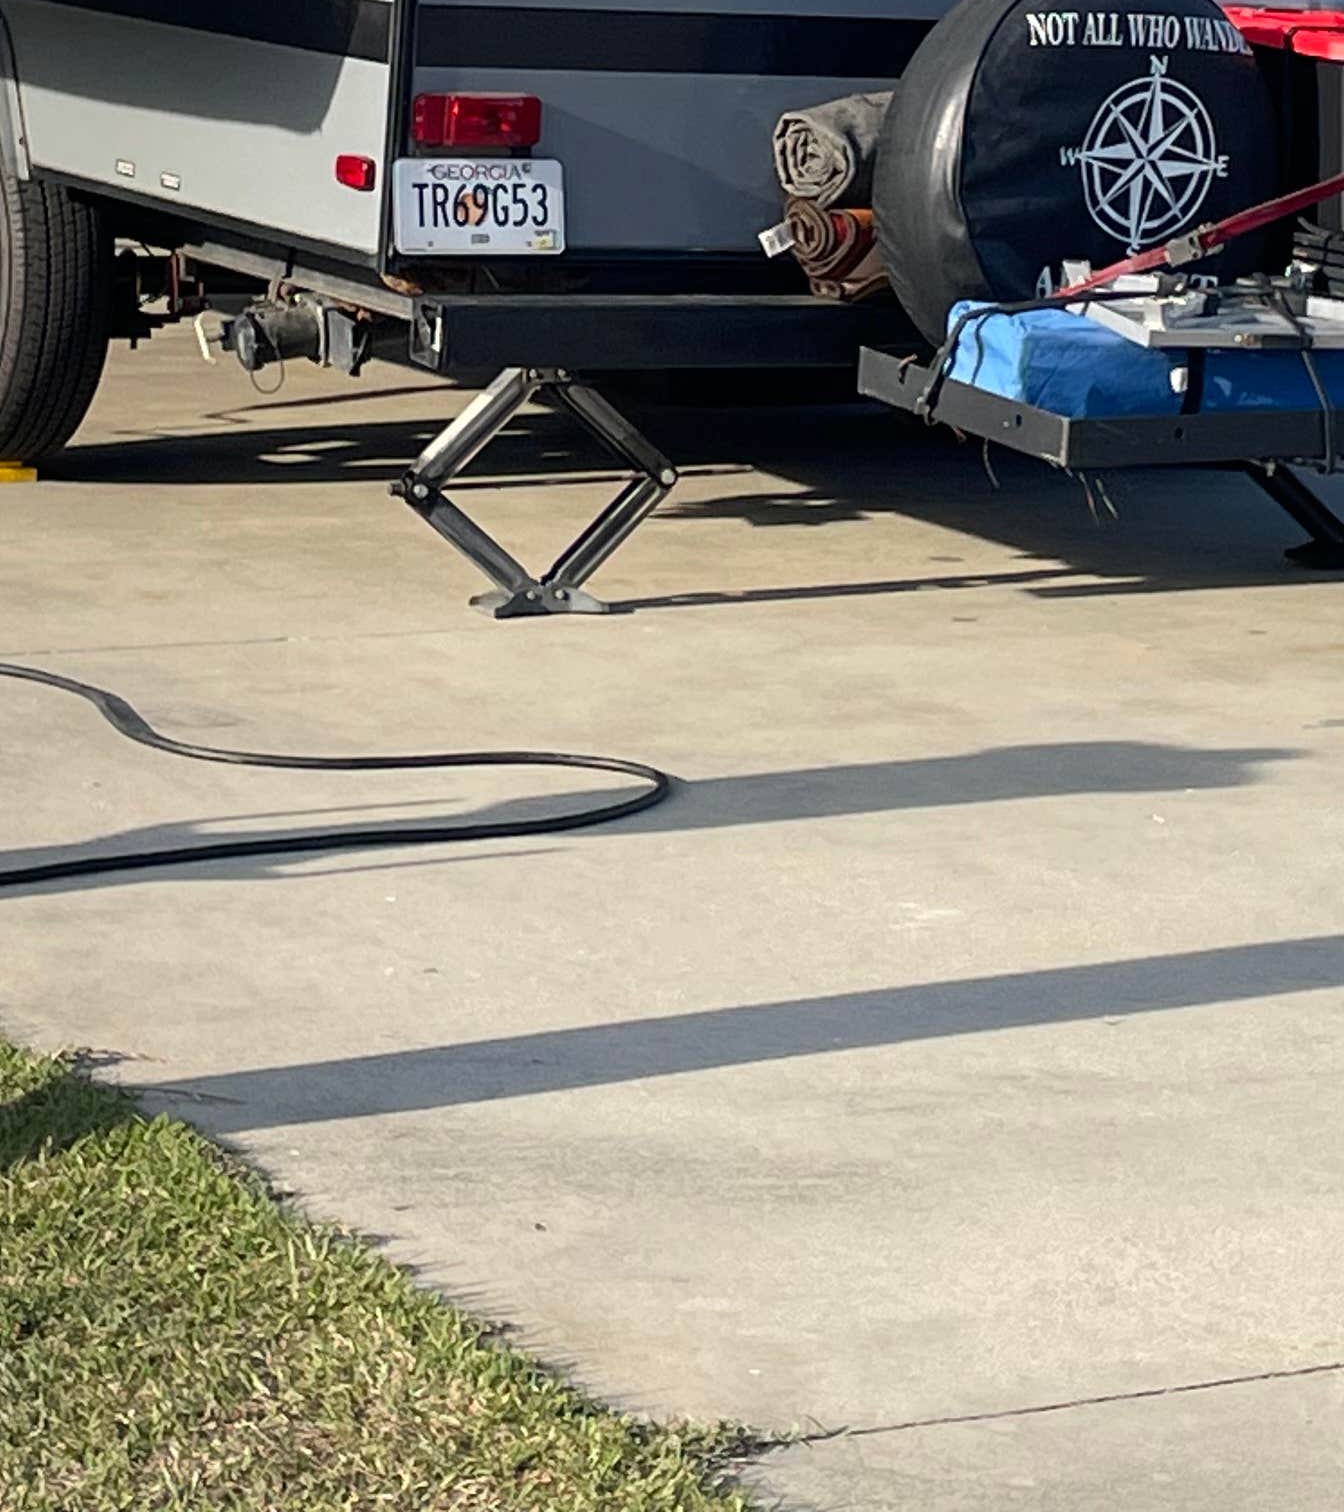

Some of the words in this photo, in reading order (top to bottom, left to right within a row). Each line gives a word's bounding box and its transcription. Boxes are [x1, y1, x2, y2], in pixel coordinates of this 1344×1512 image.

[1026, 12, 1079, 46] NOT
[1083, 13, 1123, 46] ALL
[1127, 14, 1180, 49] WHO
[1150, 55, 1168, 75] N
[1060, 146, 1081, 166] W
[431, 164, 522, 180] GEORGIA
[1216, 156, 1230, 177] E
[412, 184, 548, 227] TR69G53
